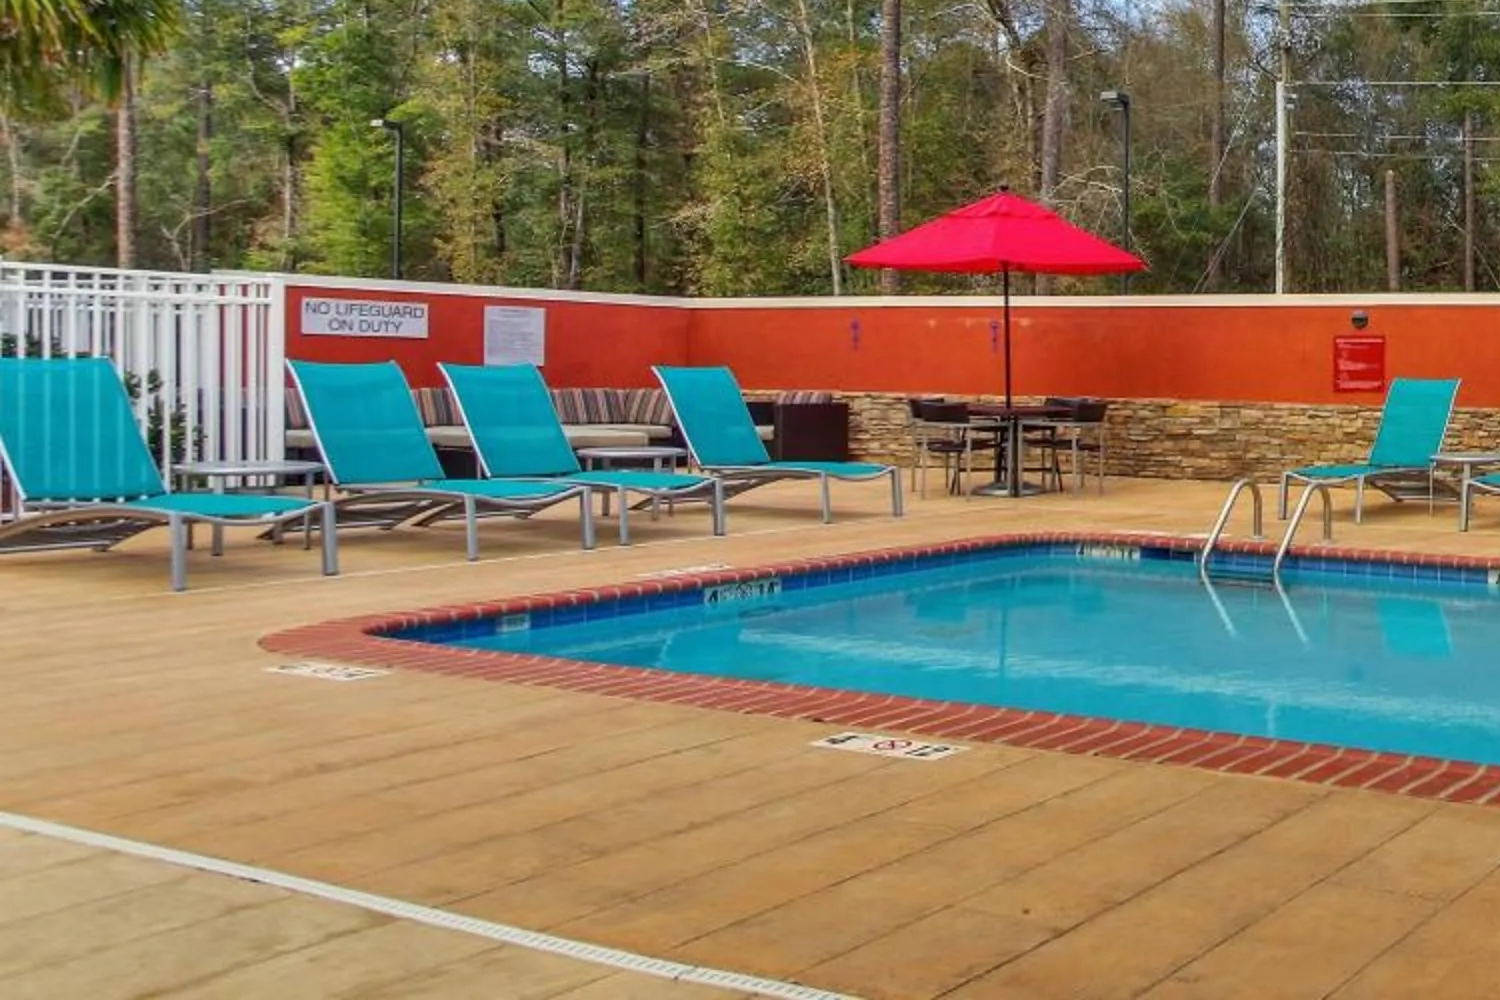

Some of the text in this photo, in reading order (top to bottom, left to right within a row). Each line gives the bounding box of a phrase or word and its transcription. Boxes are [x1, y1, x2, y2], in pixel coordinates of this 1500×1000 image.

[305, 301, 425, 319] NO LIFEGUARD
[328, 318, 403, 334] ON DUTY
